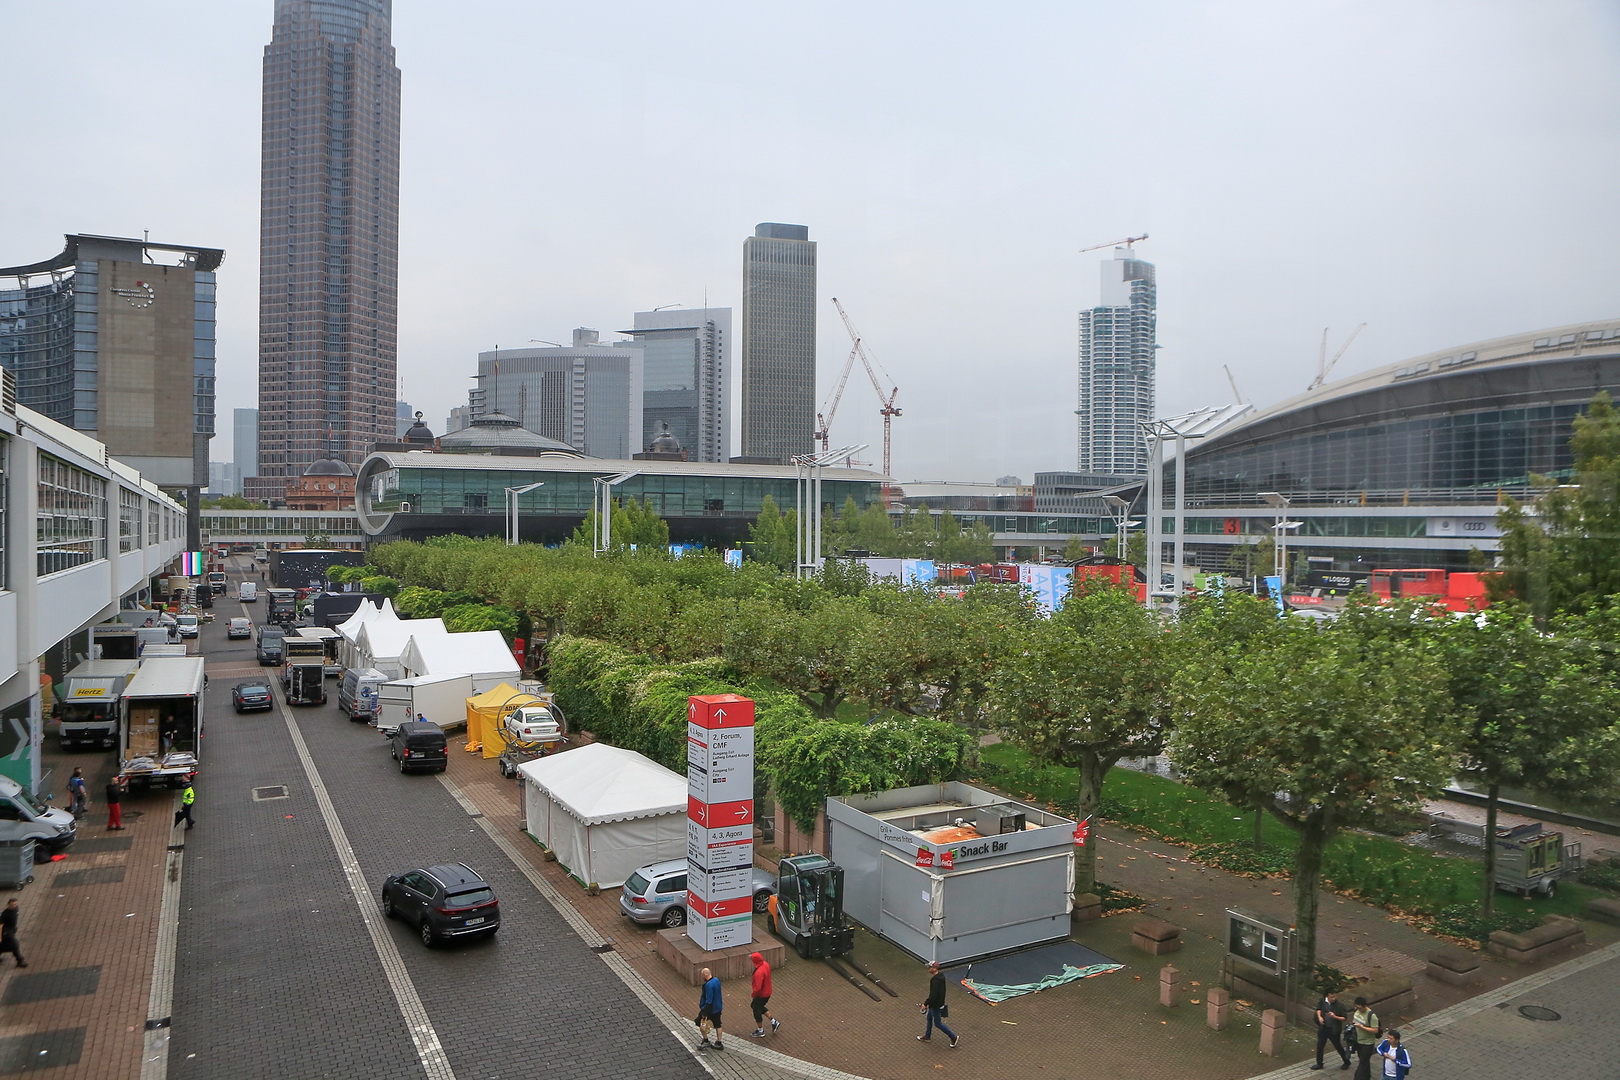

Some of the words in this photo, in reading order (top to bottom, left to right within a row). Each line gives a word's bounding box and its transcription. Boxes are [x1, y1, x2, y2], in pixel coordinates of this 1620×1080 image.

[1228, 519, 1236, 533] 3
[884, 834, 901, 843] Pommes
[901, 836, 913, 844] frites
[960, 846, 990, 858] Snack
[992, 841, 1008, 852] Bar
[791, 910, 795, 920] 5
